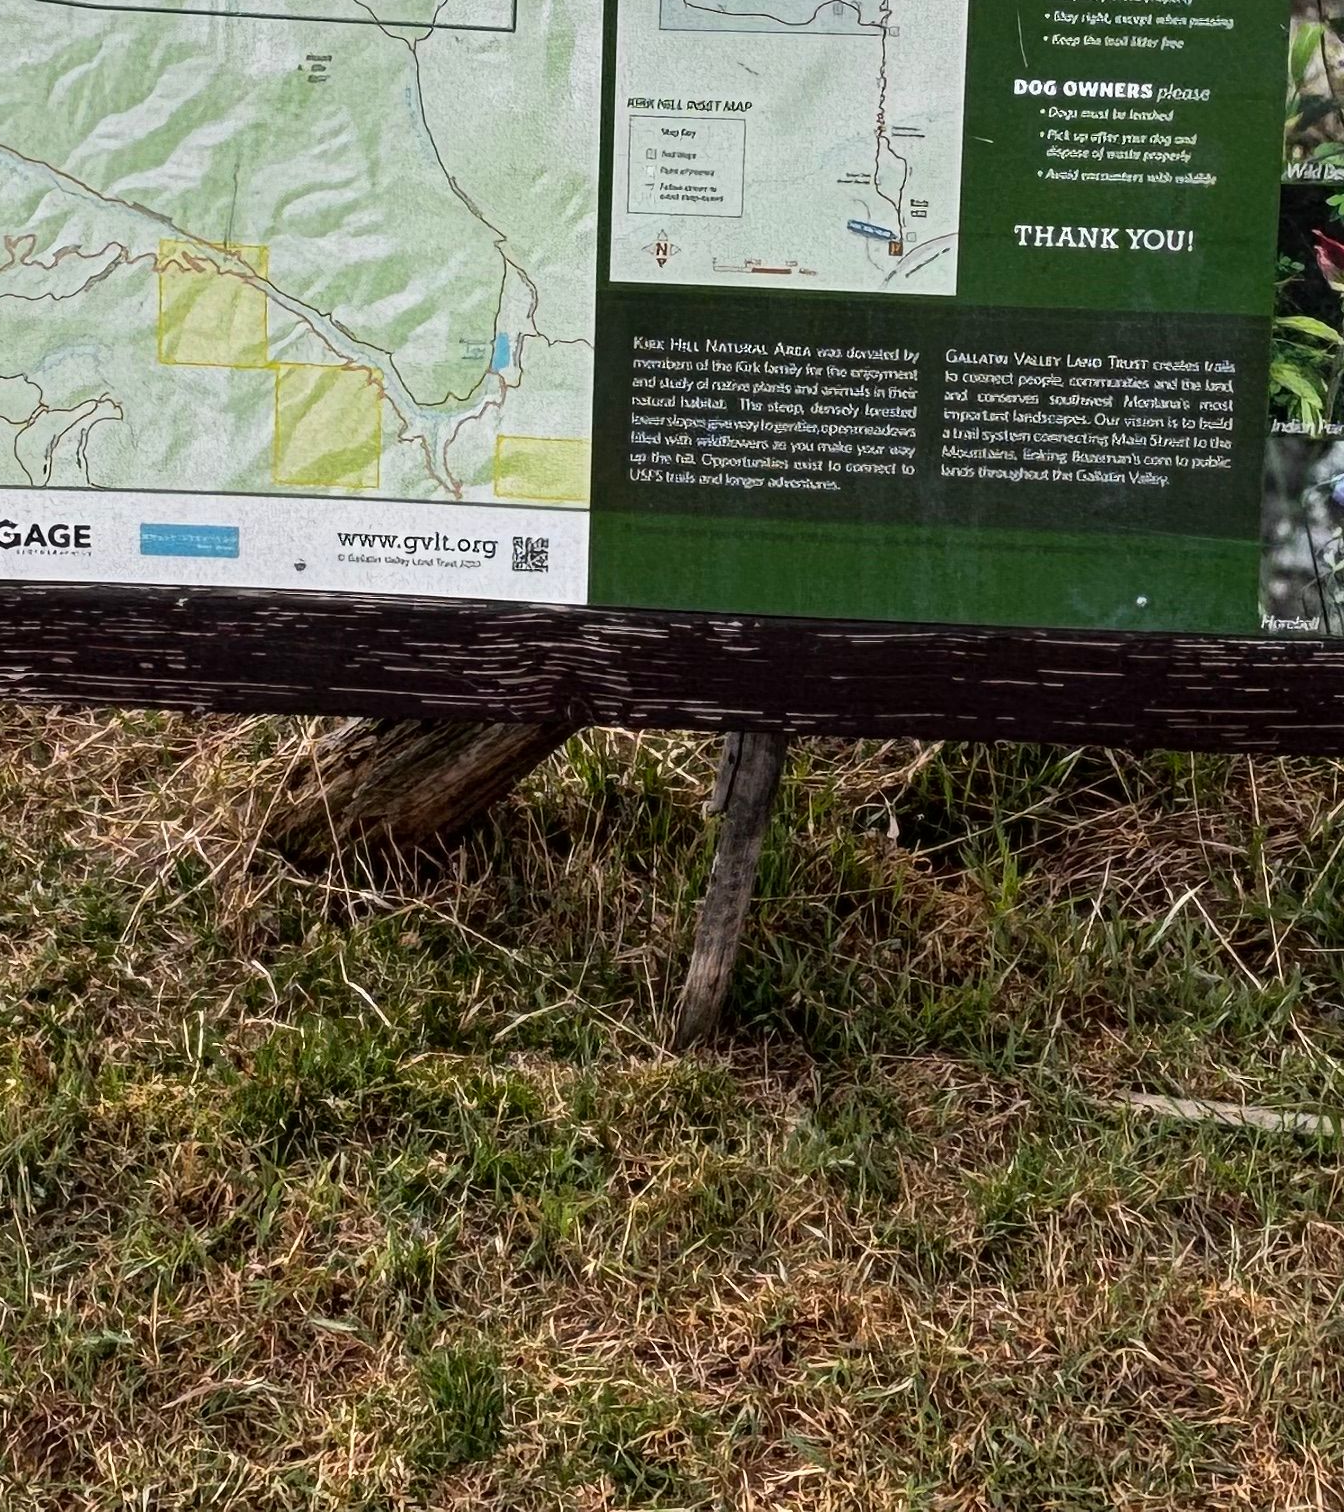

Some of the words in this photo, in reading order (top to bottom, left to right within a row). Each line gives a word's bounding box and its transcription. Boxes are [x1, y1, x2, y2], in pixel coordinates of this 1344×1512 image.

[1014, 79, 1056, 96] DOG
[1063, 81, 1153, 99] OWNERS
[1157, 84, 1210, 102] please
[1048, 106, 1078, 120] Dogs
[1047, 129, 1069, 141] Pick
[1149, 133, 1171, 146] dog
[1045, 168, 1079, 180] Avoid
[1014, 225, 1119, 249] THANK
[1126, 228, 1194, 252] YOU!
[1108, 355, 1148, 371] TRUST
[337, 531, 498, 559] www.gvlt.org
